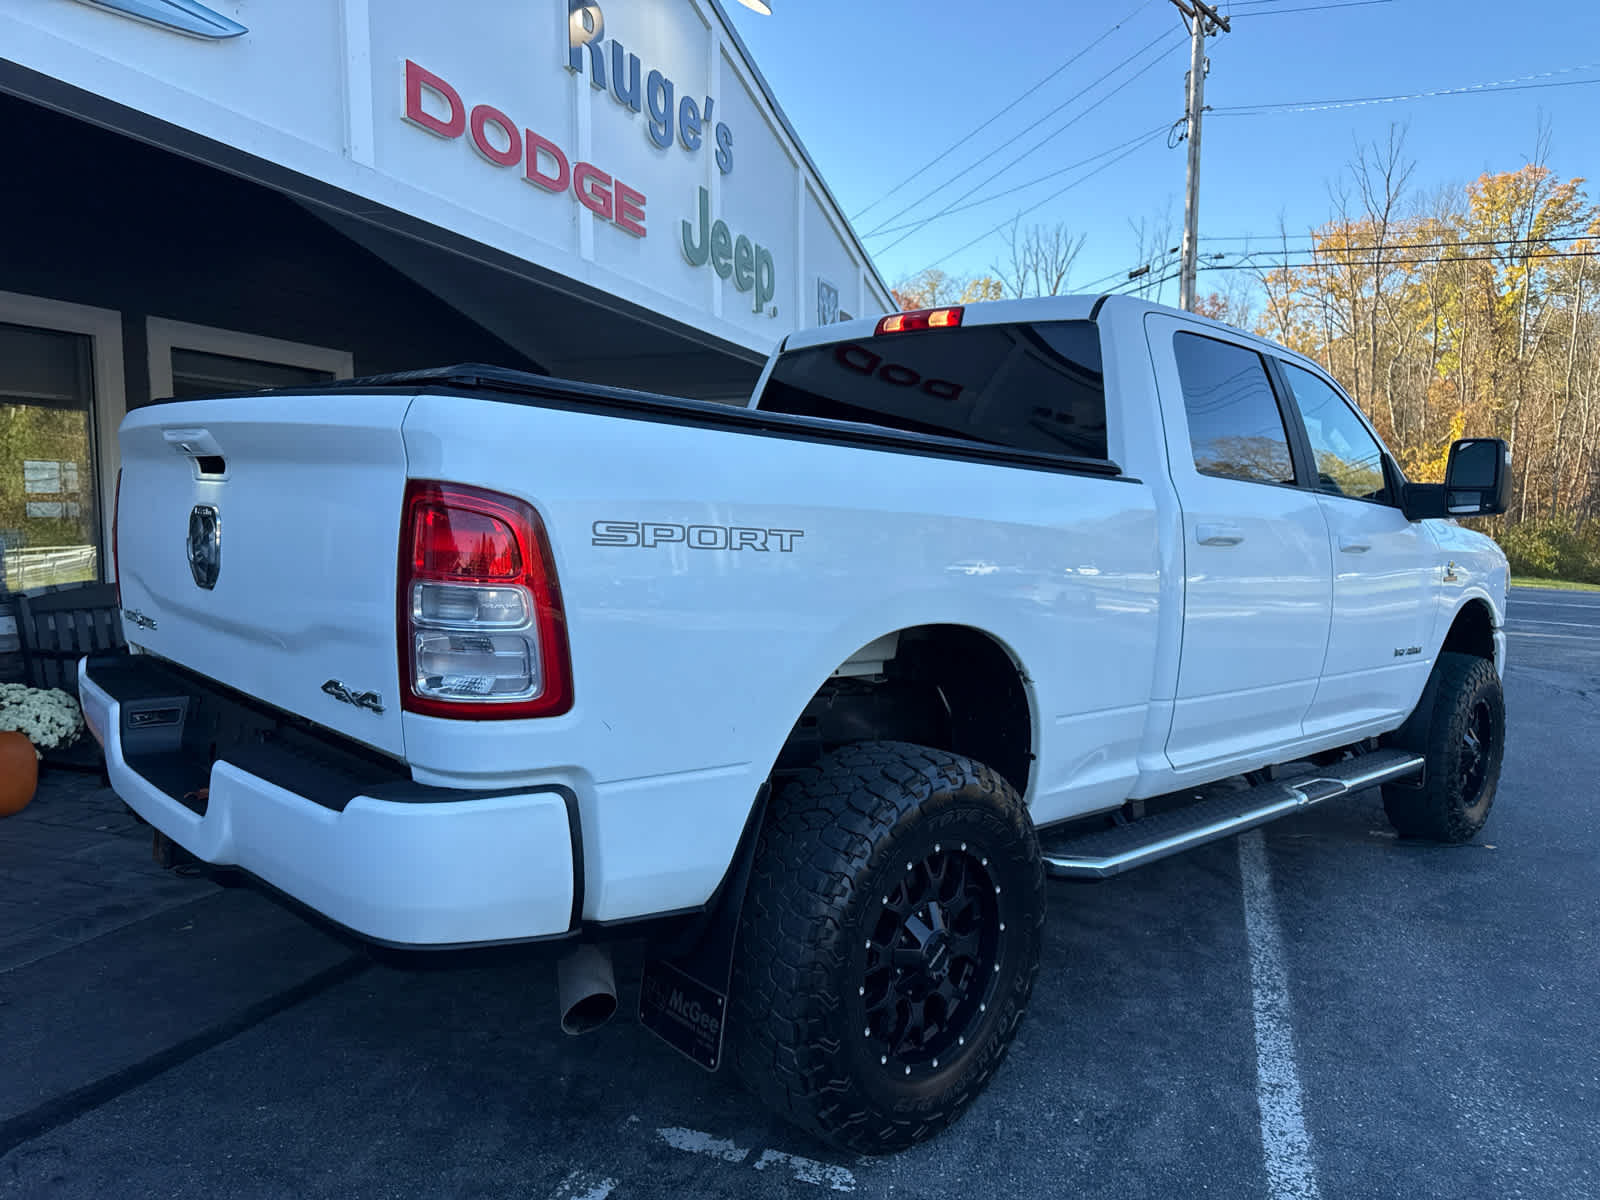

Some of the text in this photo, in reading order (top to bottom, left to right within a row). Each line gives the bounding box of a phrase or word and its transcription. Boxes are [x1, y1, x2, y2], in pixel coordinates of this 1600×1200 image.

[402, 59, 648, 239] DODGE
[567, 0, 734, 175] Ruge's
[591, 520, 805, 552] SPORT
